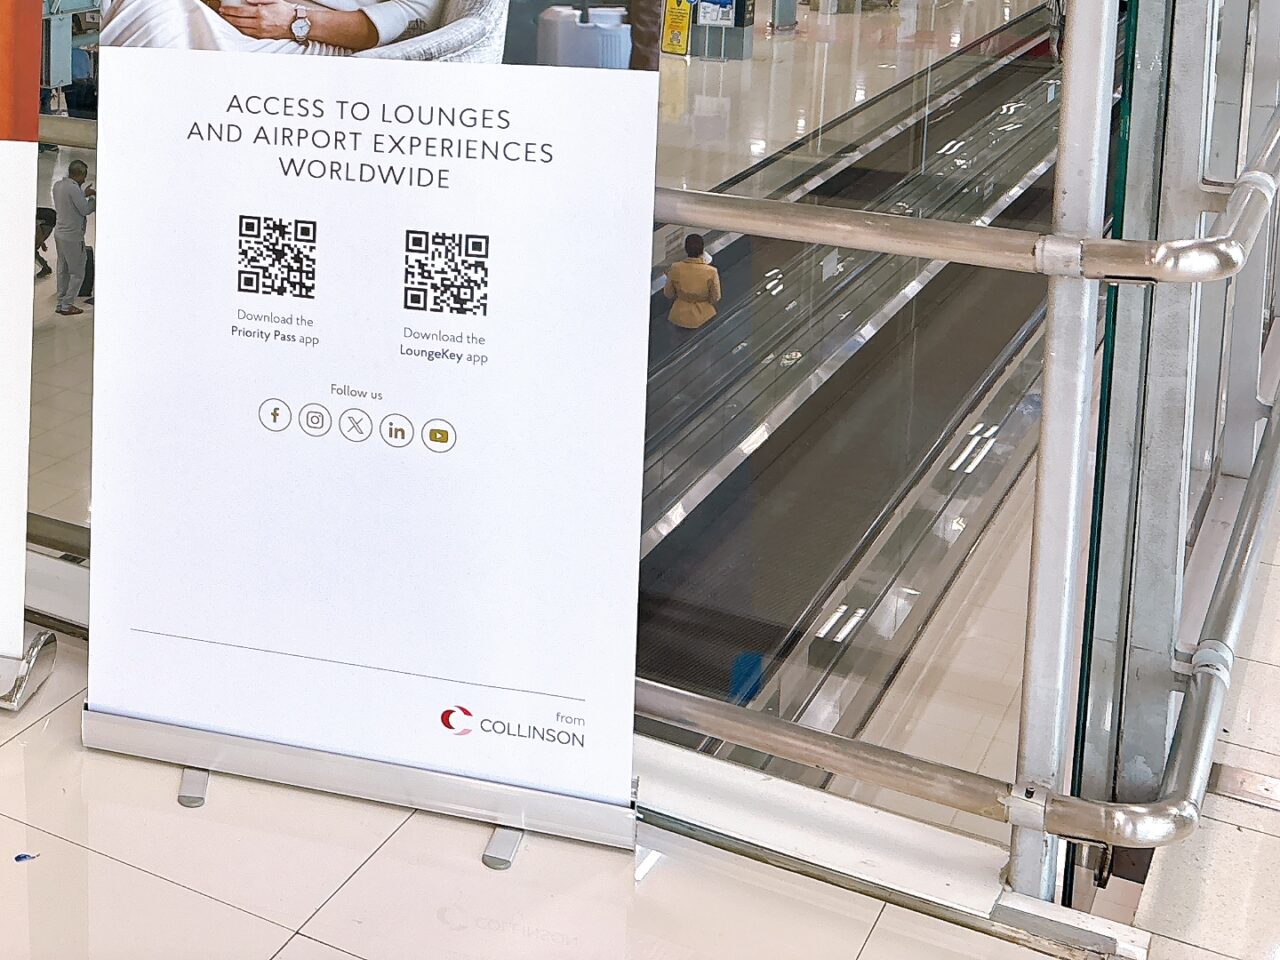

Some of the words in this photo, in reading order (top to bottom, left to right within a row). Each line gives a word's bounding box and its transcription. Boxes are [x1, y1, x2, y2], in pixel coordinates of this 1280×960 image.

[225, 94, 324, 118] ACCESS
[335, 100, 369, 121] TO
[381, 103, 510, 129] LOUNGES
[186, 121, 242, 142] AND
[252, 125, 362, 150] AIRPORT
[373, 133, 552, 163] EXPERIENCES
[278, 156, 449, 188] WORLDWIDE
[237, 308, 292, 324] Download
[295, 314, 313, 327] the
[231, 325, 270, 342] Priority
[273, 329, 296, 342] Pass
[298, 335, 319, 347] app
[403, 326, 462, 343] Download
[466, 332, 485, 345] the
[400, 343, 463, 363] LoungeKey
[466, 353, 487, 365] app
[330, 383, 367, 397] Follow
[370, 392, 382, 400] us
[555, 711, 585, 726] from
[480, 718, 584, 747] COLLINSON
